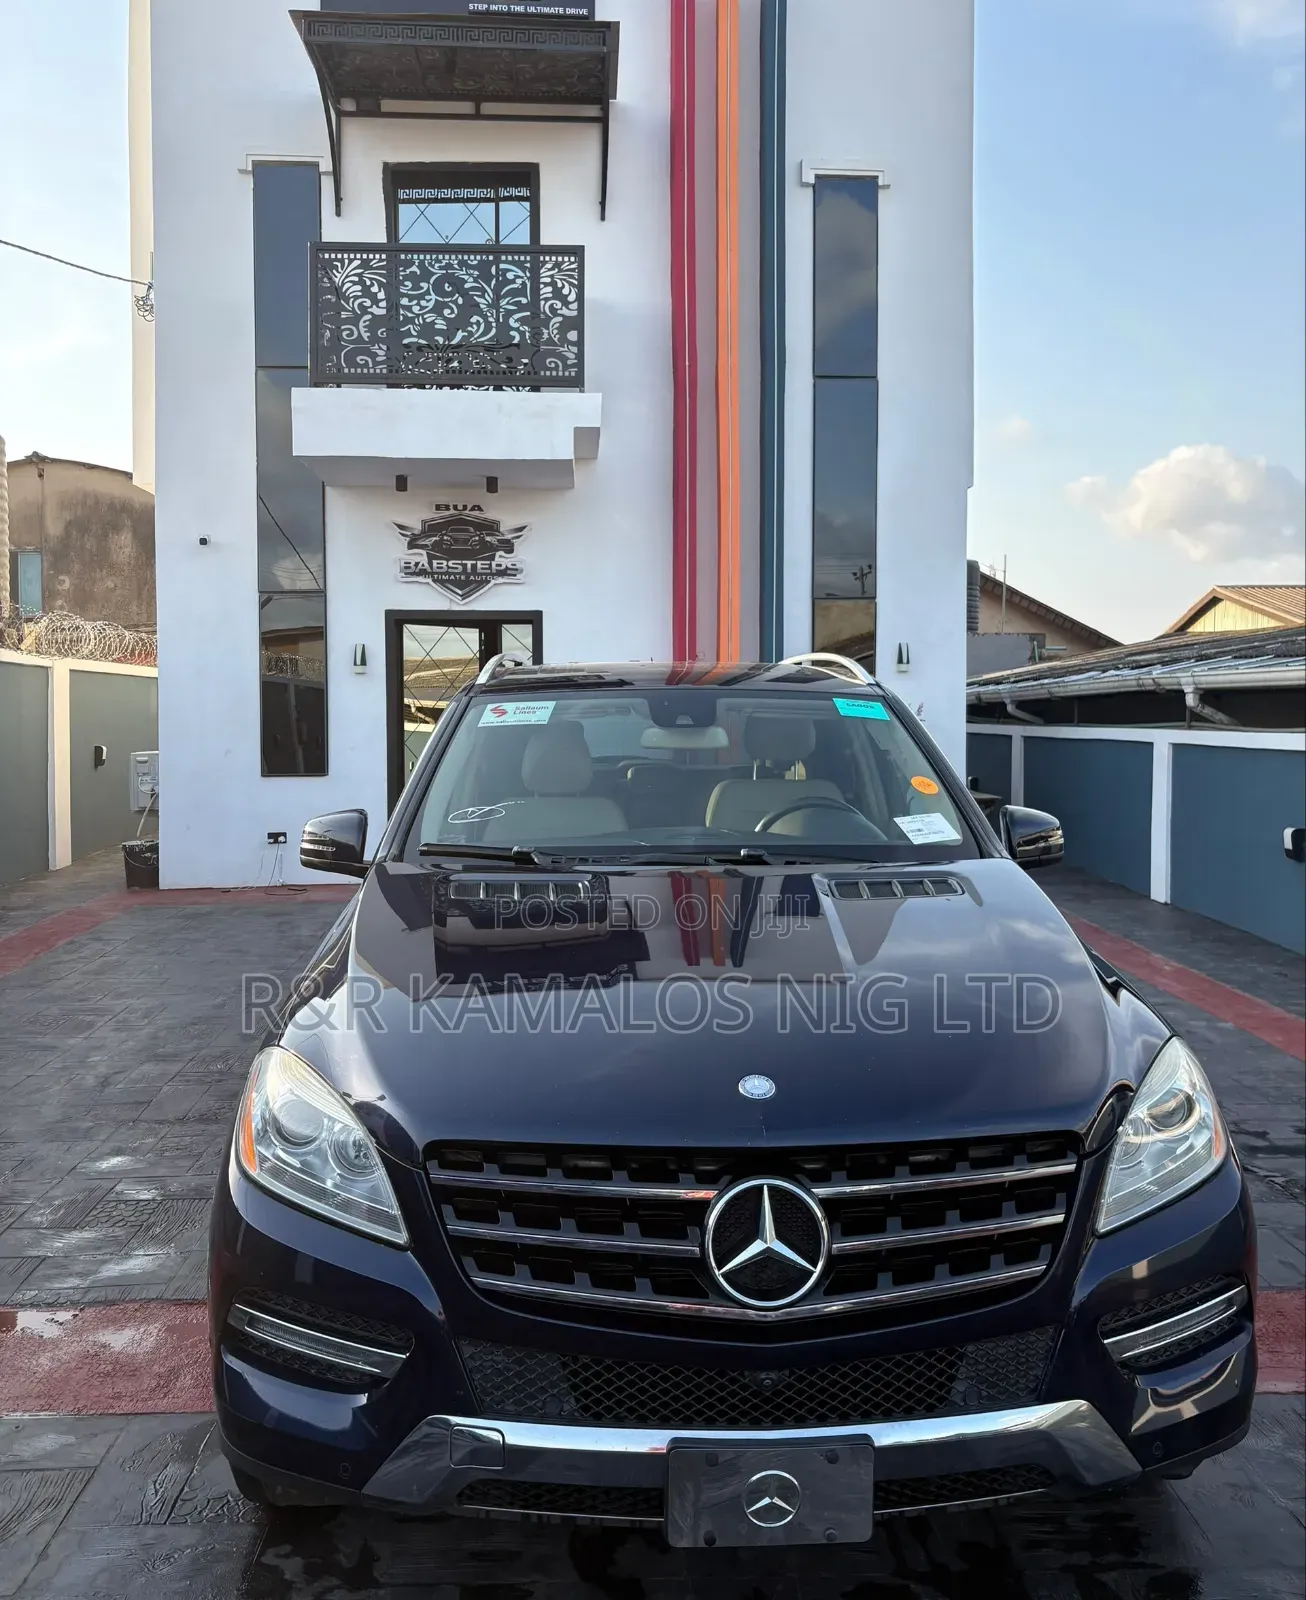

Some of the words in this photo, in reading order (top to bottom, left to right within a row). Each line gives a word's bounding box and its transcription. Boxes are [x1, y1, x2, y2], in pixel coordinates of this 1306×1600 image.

[468, 3, 487, 11] STEP
[489, 4, 508, 12] INTO
[510, 5, 525, 13] THE
[527, 6, 564, 14] ULTIMATE
[566, 7, 589, 15] DRIVE
[434, 503, 484, 512] BUA
[399, 558, 525, 575] BABSTEPS
